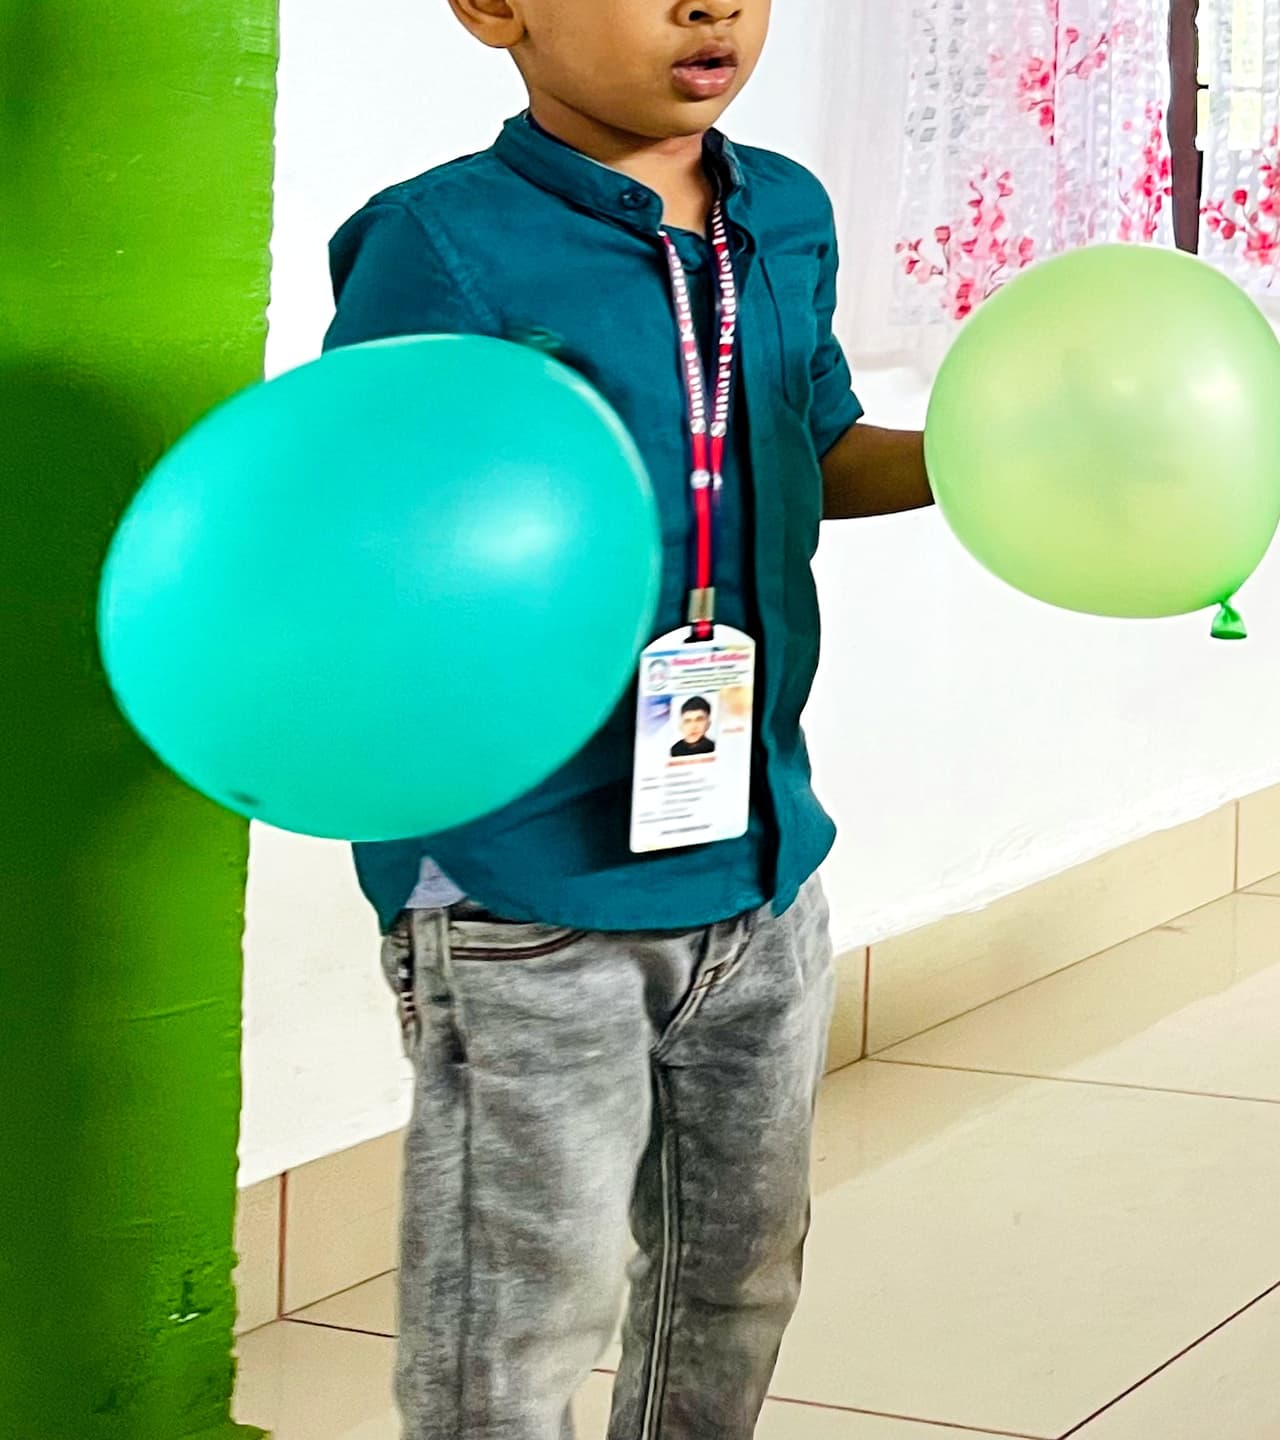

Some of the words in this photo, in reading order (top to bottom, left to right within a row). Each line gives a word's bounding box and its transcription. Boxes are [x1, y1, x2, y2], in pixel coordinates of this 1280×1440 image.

[718, 248, 737, 345] Kiddies
[685, 351, 707, 435] Smart
[710, 353, 732, 437] Smart
